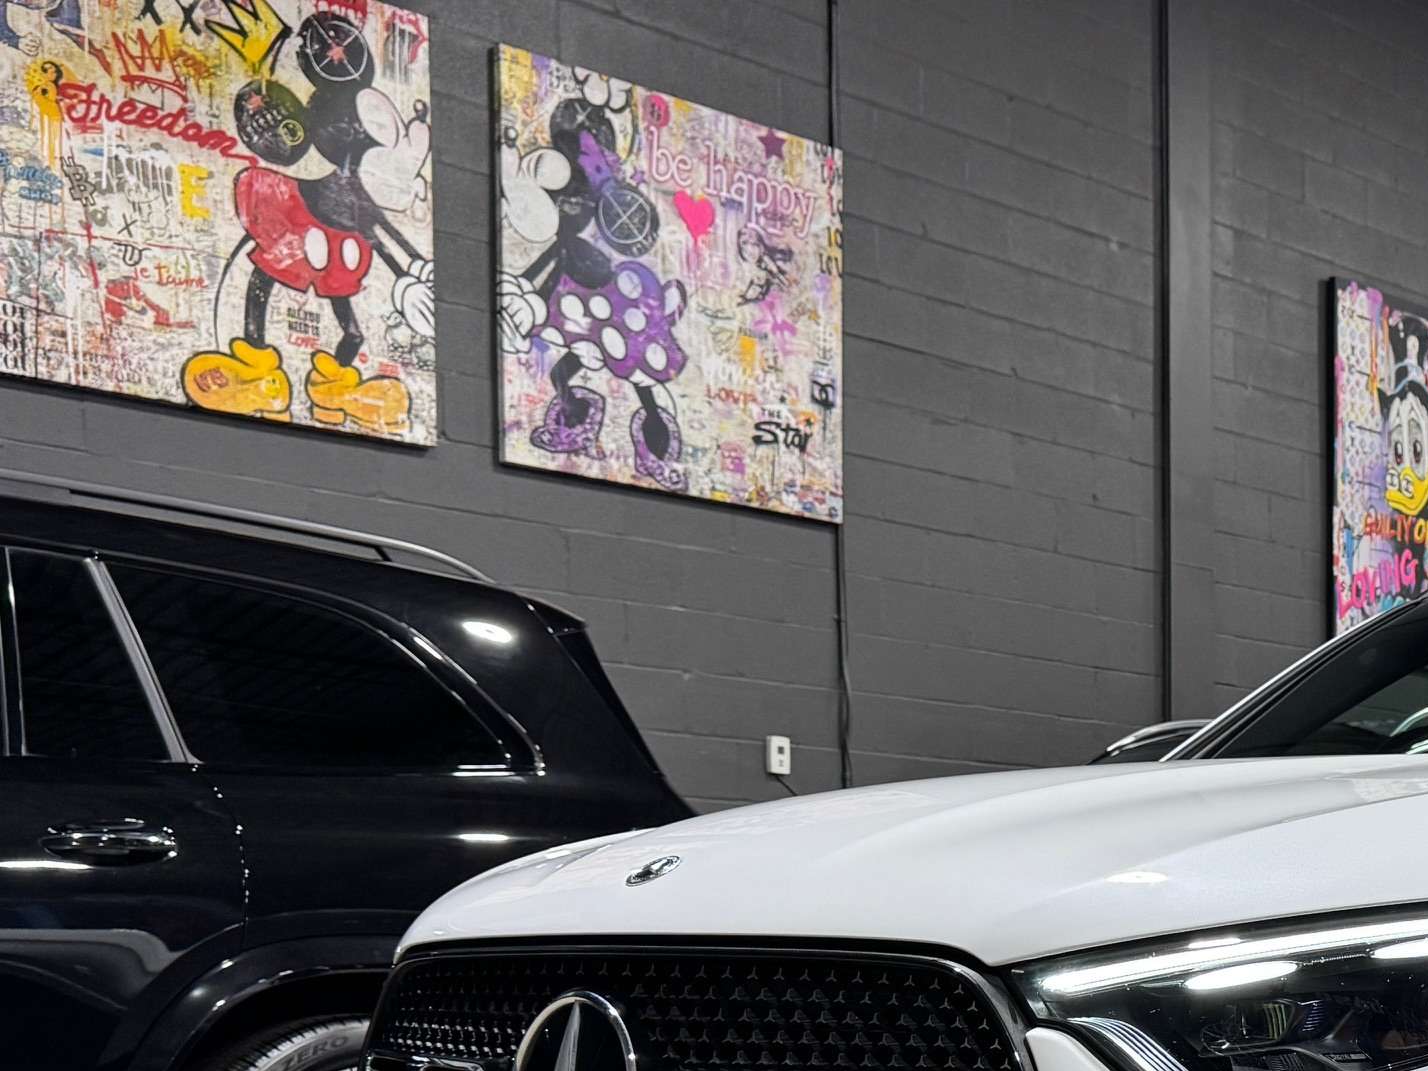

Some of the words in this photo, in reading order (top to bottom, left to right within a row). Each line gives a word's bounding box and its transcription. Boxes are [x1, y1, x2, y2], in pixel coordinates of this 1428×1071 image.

[57, 82, 258, 164] Freedom
[646, 125, 692, 187] be
[703, 139, 817, 238] happy
[1363, 511, 1412, 544] GUILTY
